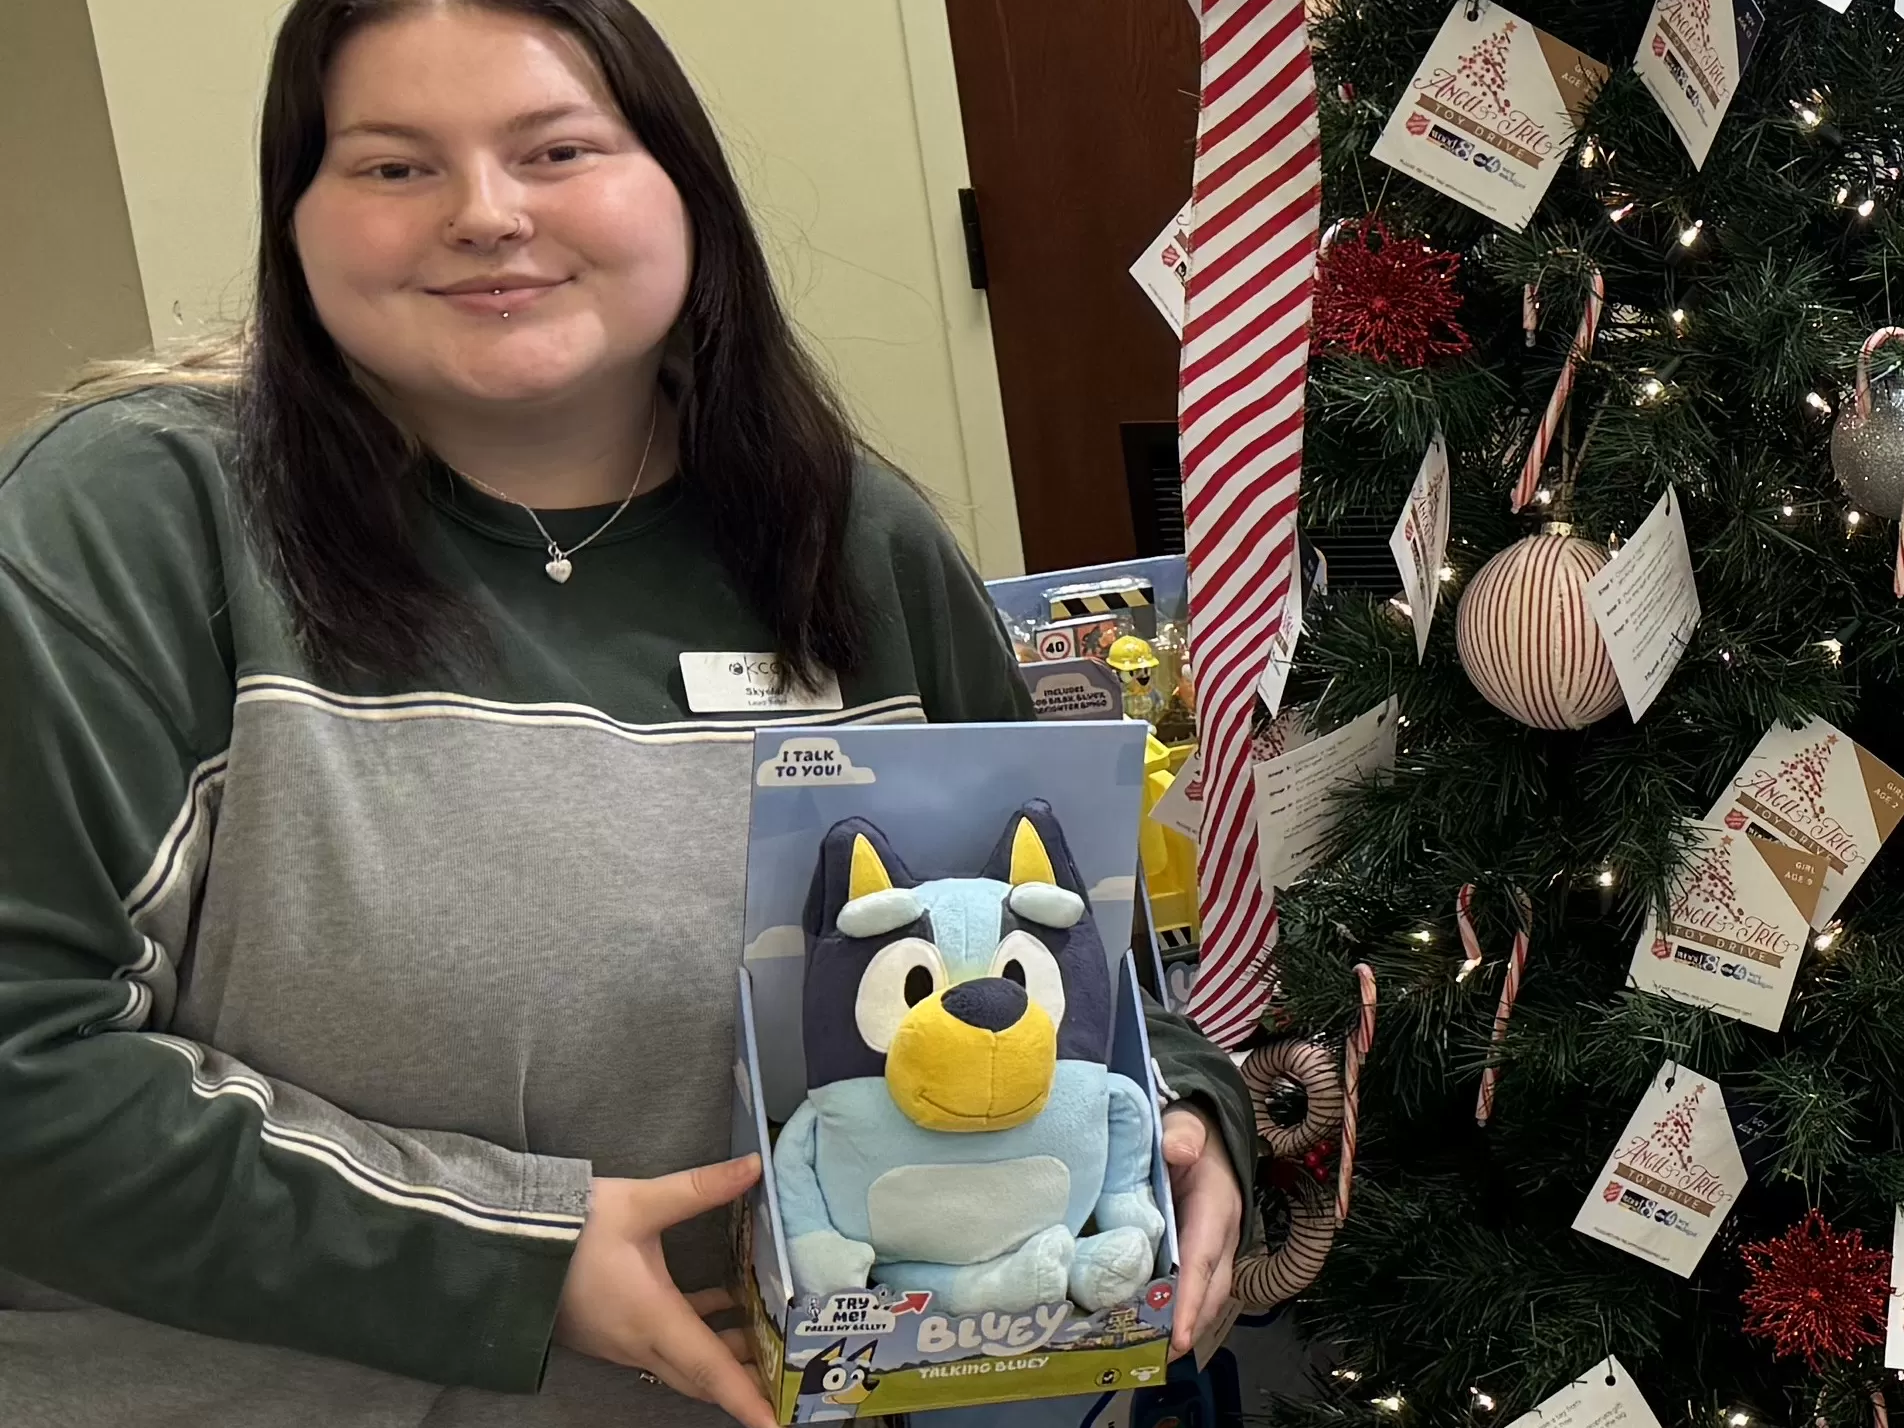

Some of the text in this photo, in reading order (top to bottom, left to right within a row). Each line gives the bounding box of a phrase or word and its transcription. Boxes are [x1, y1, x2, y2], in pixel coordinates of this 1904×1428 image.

[1045, 641, 1065, 654] 40
[775, 764, 843, 778] TO YOU!
[834, 1297, 870, 1310] TRY
[915, 1301, 1072, 1357] BLUEY
[918, 1355, 1050, 1380] TALKING BLUEY
